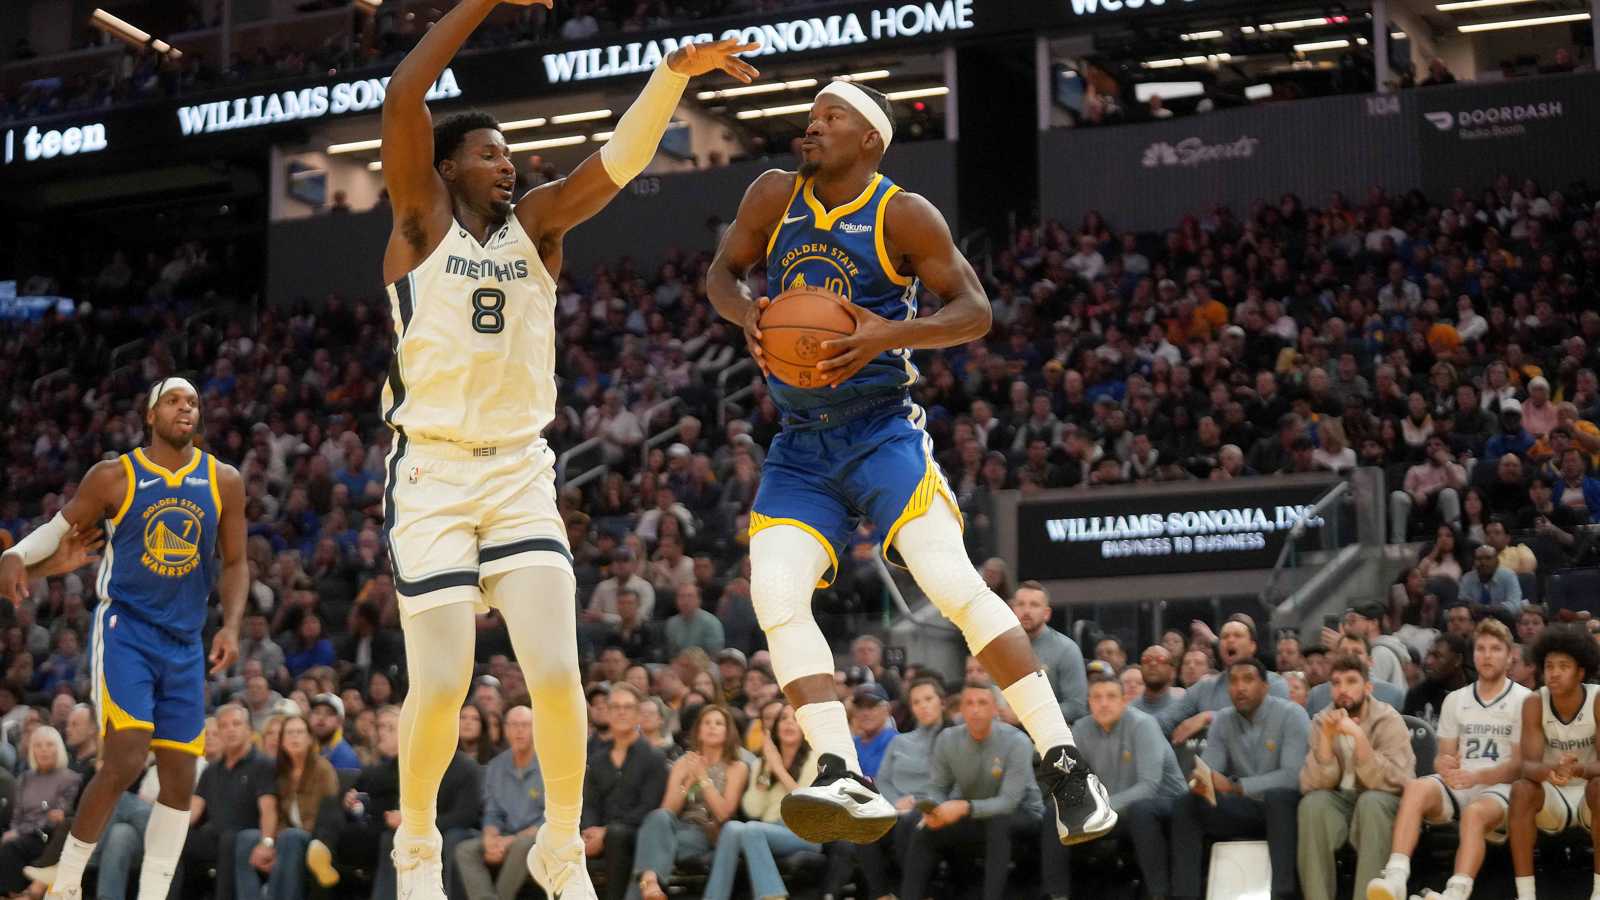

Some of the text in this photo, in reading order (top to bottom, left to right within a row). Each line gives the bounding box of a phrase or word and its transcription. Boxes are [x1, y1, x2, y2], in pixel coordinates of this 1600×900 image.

[870, 0, 975, 40] HOME
[177, 67, 463, 136] WILLIAMS SONA
[1458, 101, 1563, 126] DOORDASH
[22, 123, 108, 161] teen
[839, 221, 872, 233] Rakuten
[445, 254, 529, 282] MEMHIS
[781, 243, 860, 278] GOLDEN STATE
[472, 287, 506, 334] 8
[142, 497, 178, 519] GOLDEN
[183, 519, 194, 538] 7
[1101, 532, 1266, 559] BUSINESS TO BUSINESS
[1465, 738, 1500, 762] 24
